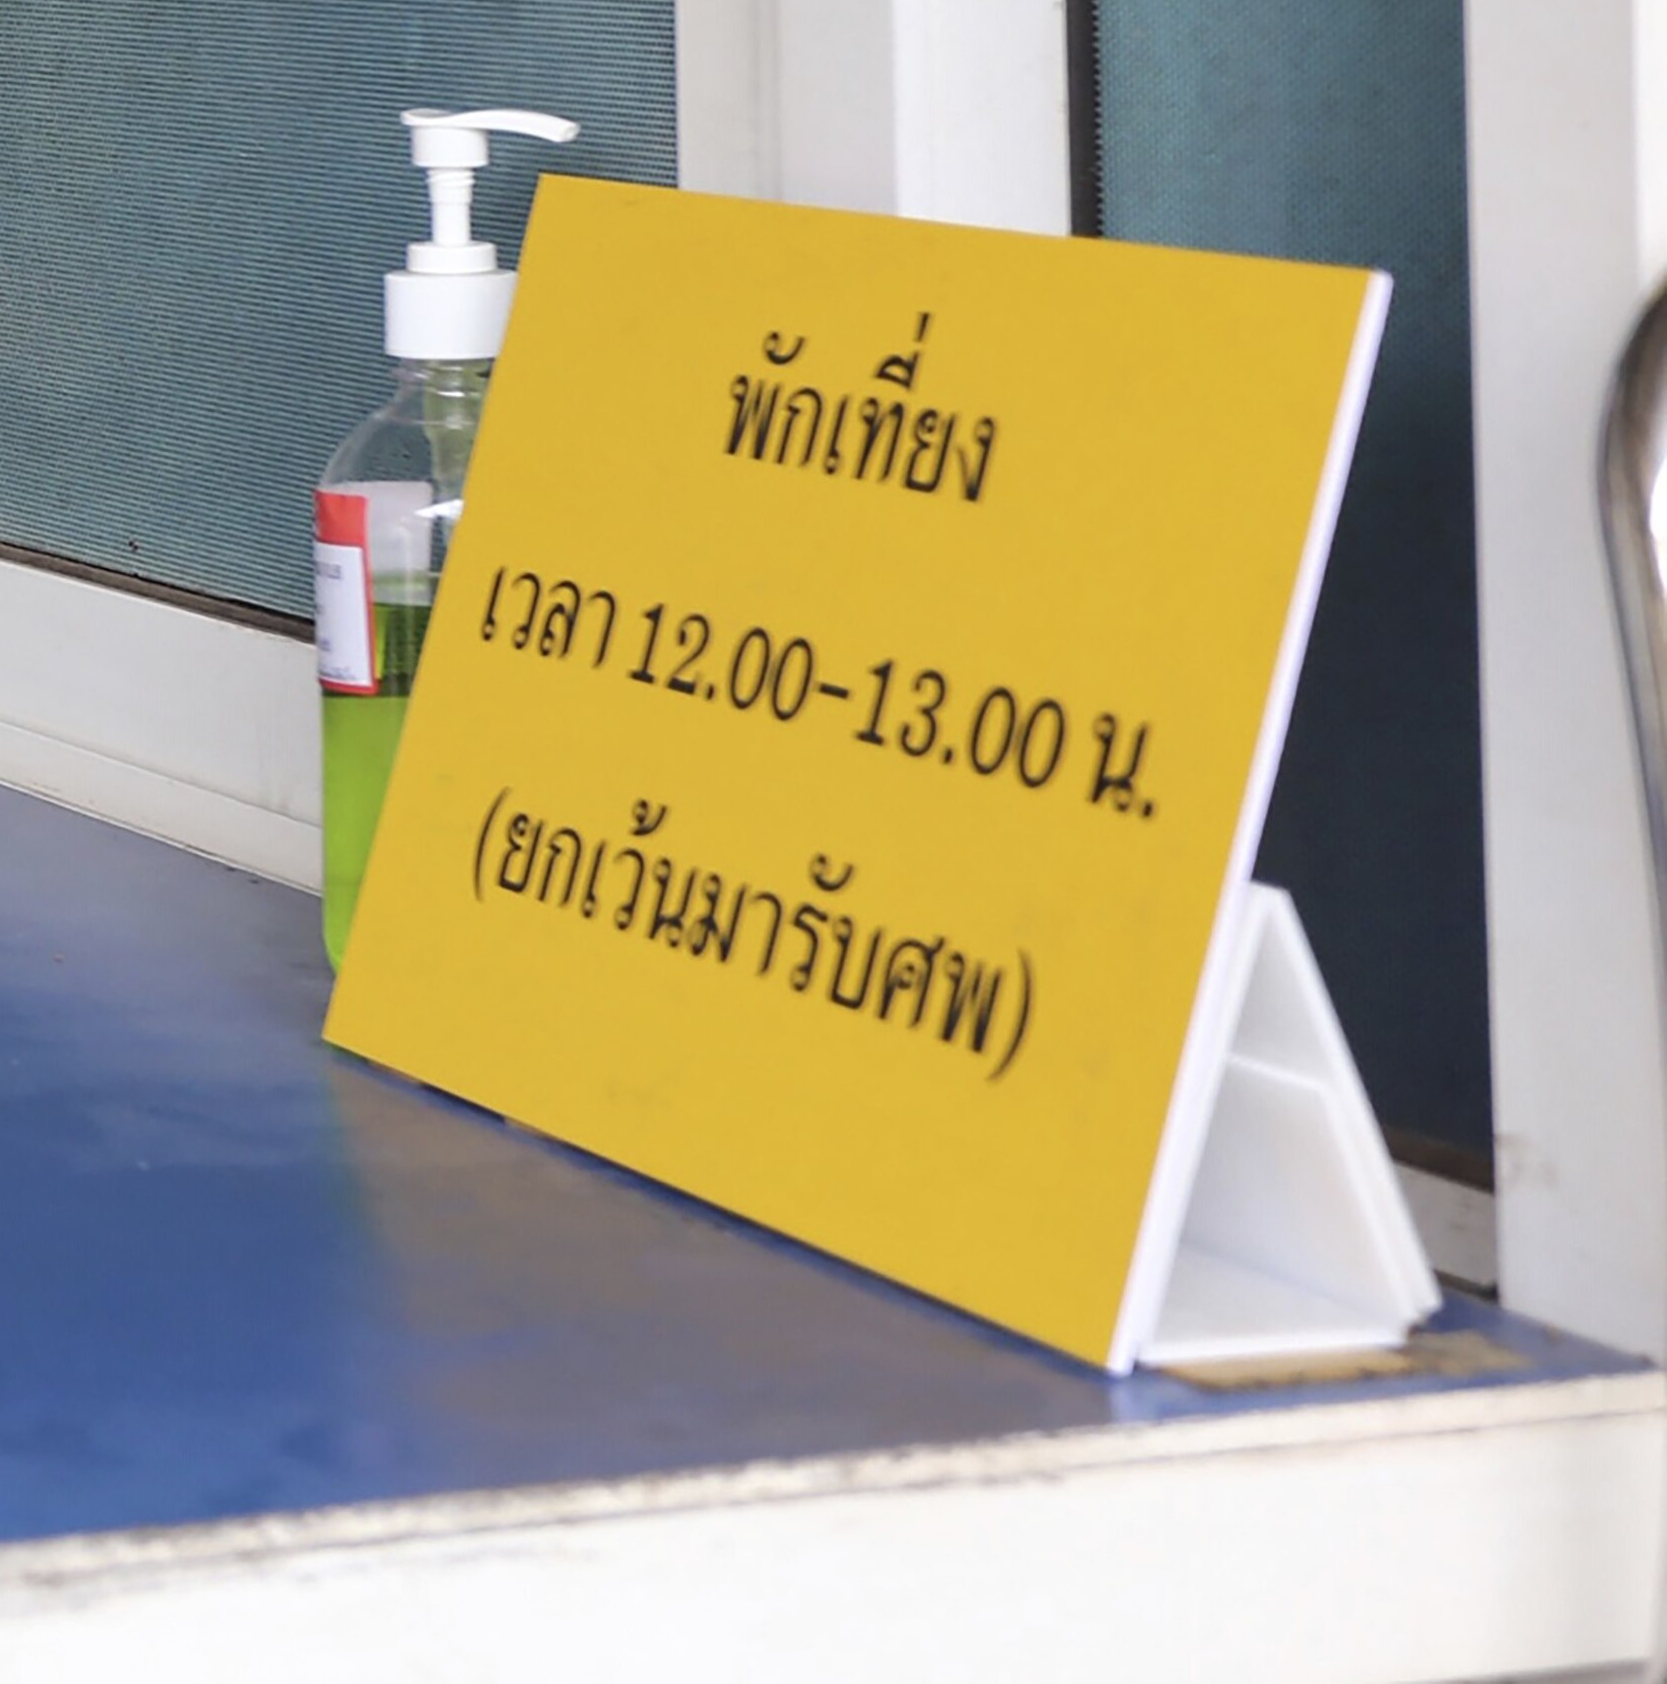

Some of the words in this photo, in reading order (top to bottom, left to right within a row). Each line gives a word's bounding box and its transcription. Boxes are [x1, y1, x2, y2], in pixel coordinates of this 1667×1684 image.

[724, 311, 997, 503] พักเที่ยง
[480, 568, 618, 668] เวลา
[627, 601, 1067, 790] 12.00-13.00
[1088, 712, 1156, 819] น.
[473, 786, 1033, 1083] (ยกเว้นมารับศพ)
